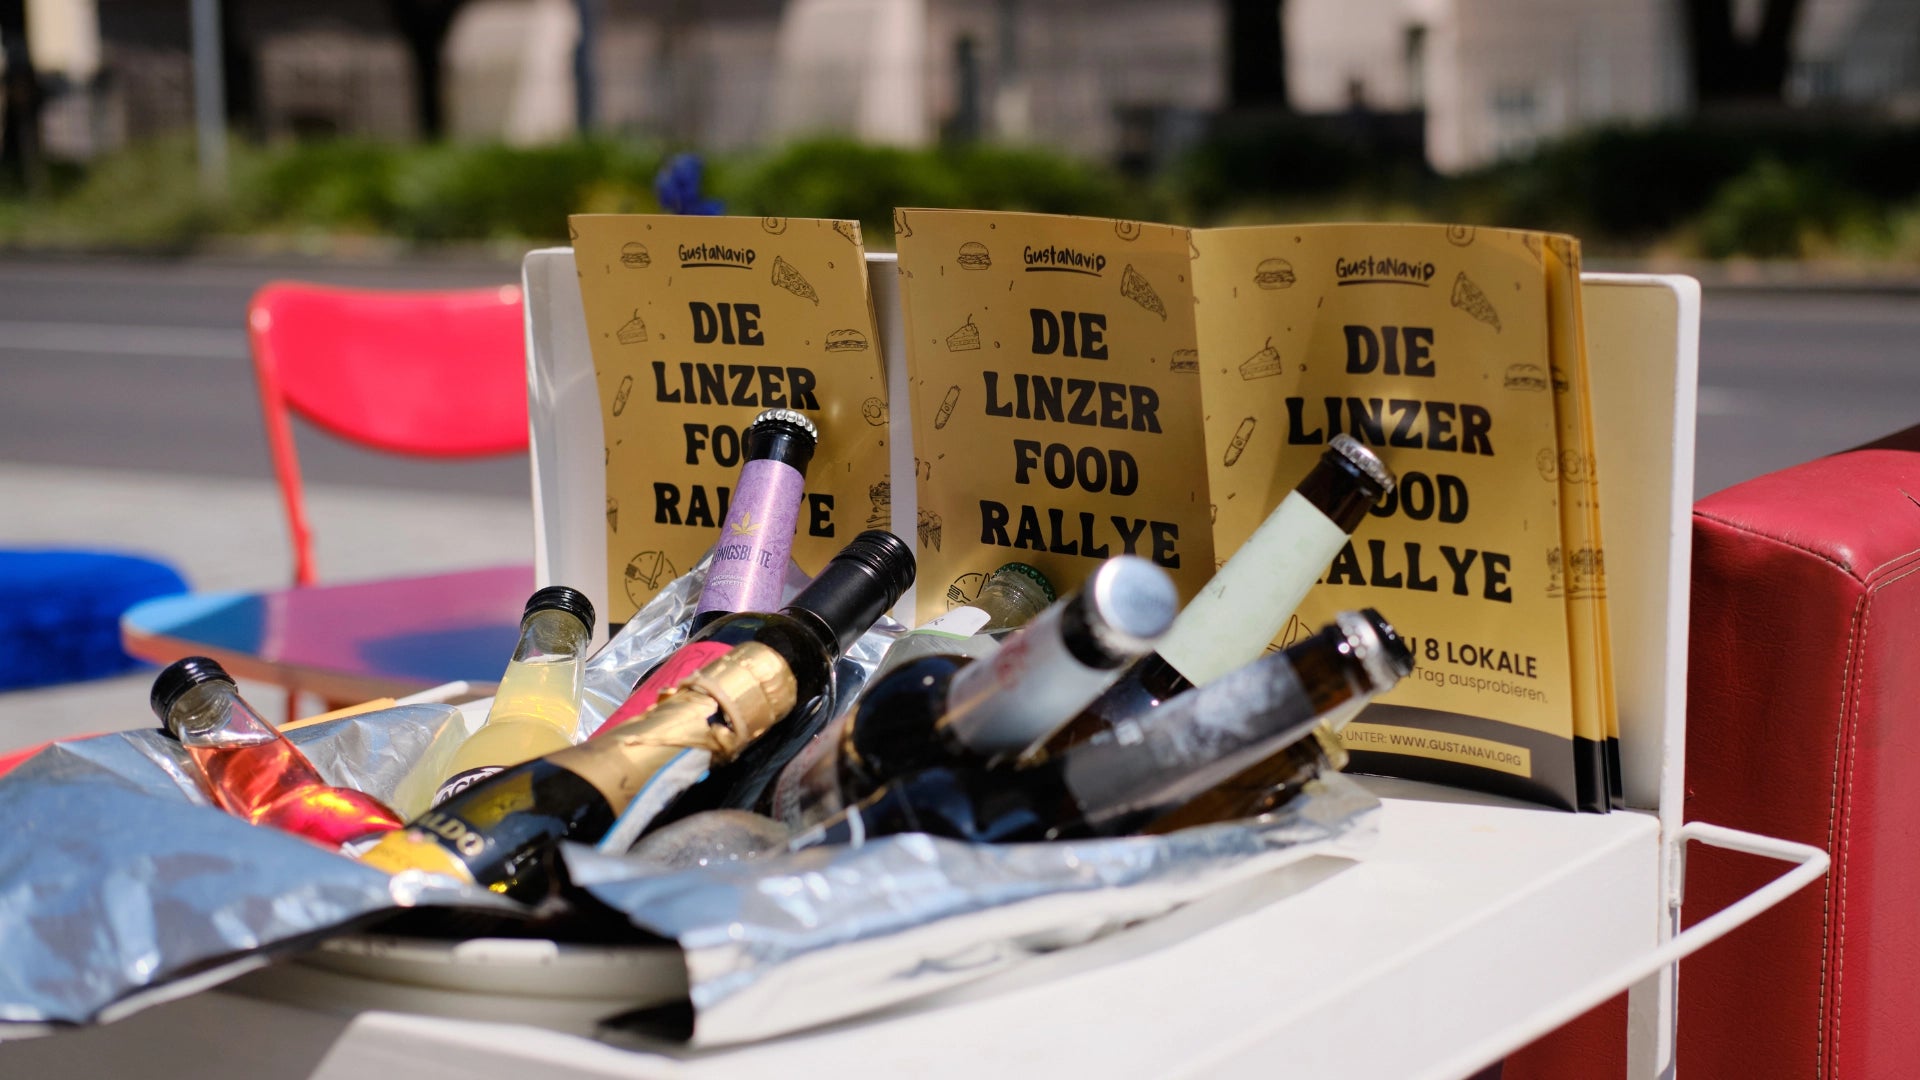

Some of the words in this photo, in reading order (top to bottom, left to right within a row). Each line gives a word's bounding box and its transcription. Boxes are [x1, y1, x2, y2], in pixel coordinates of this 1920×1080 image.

[689, 302, 765, 346] DIE
[1030, 308, 1109, 360] DIE
[1344, 325, 1436, 377] DIE
[652, 361, 820, 410] LINZER
[983, 371, 1163, 434] LINZER
[1285, 397, 1495, 456] LINZER
[1013, 439, 1139, 496] FOOD
[979, 500, 1181, 568] RALLYE
[1315, 540, 1512, 603] ALLYE
[1425, 638, 1439, 661] 8
[1447, 642, 1537, 679] LOKALE
[1416, 667, 1445, 687] Tag
[1449, 673, 1548, 704] ausprobieren.
[1346, 731, 1387, 744] UNTER:
[1389, 734, 1522, 766] WWW.GUSTANAVI.ORG
